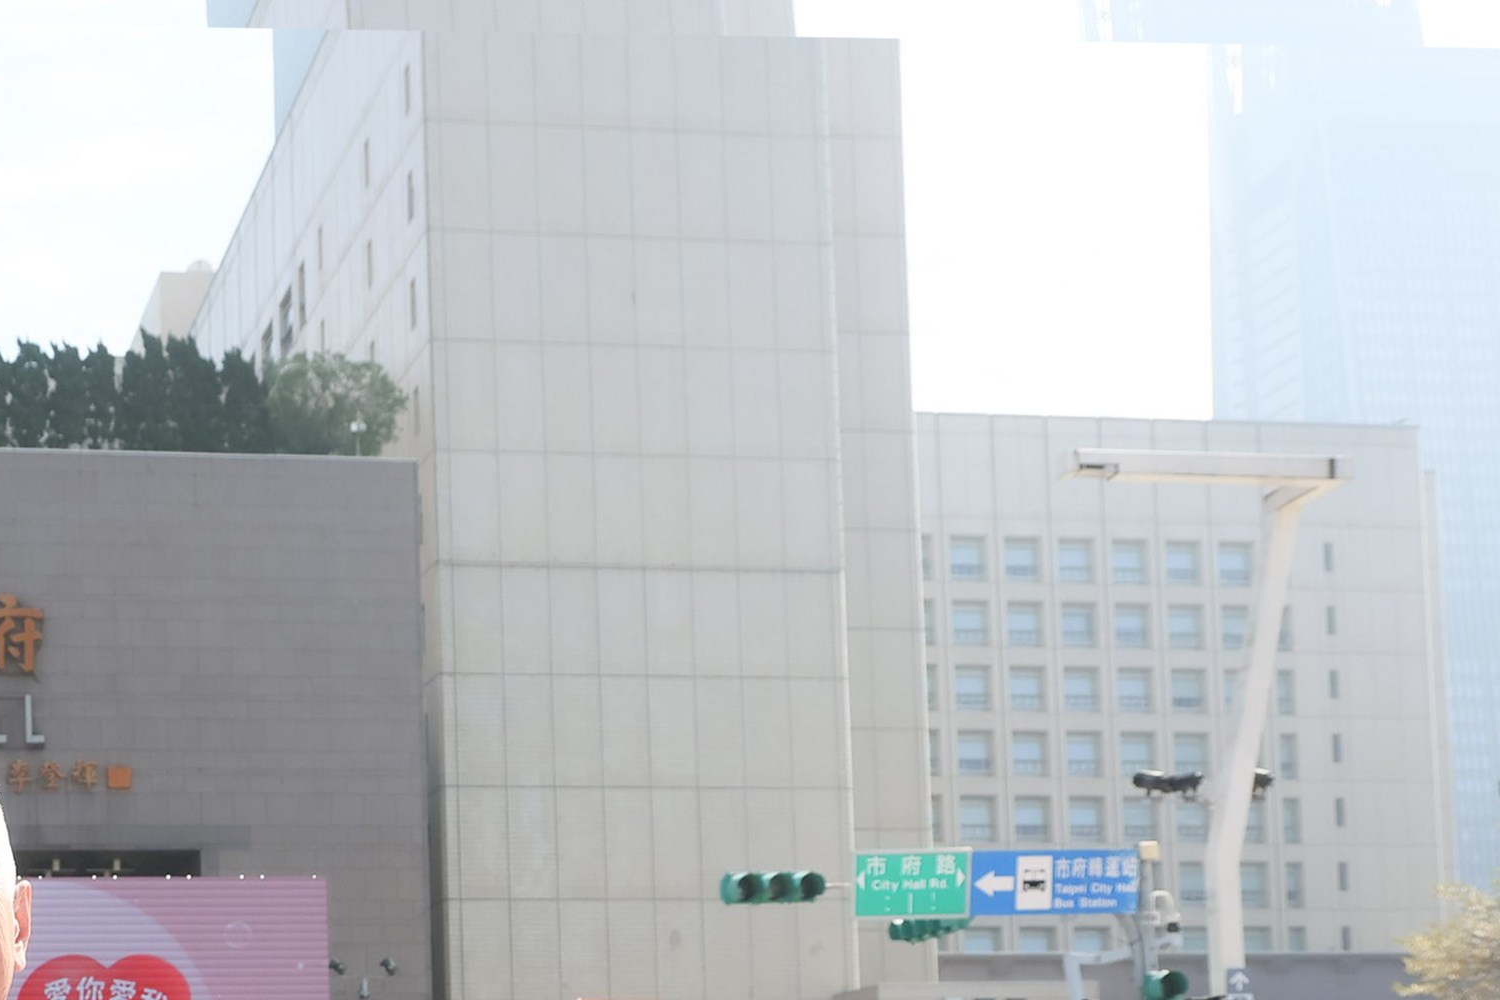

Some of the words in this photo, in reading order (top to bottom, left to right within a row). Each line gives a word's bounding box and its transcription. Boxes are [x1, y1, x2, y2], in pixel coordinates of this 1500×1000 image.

[866, 855, 956, 876] 市府路
[871, 879, 900, 893] City
[902, 879, 927, 890] Hall
[1054, 882, 1087, 896] Taipei
[1089, 882, 1114, 895] City
[1054, 897, 1075, 908] Bus
[1079, 897, 1118, 908] Station
